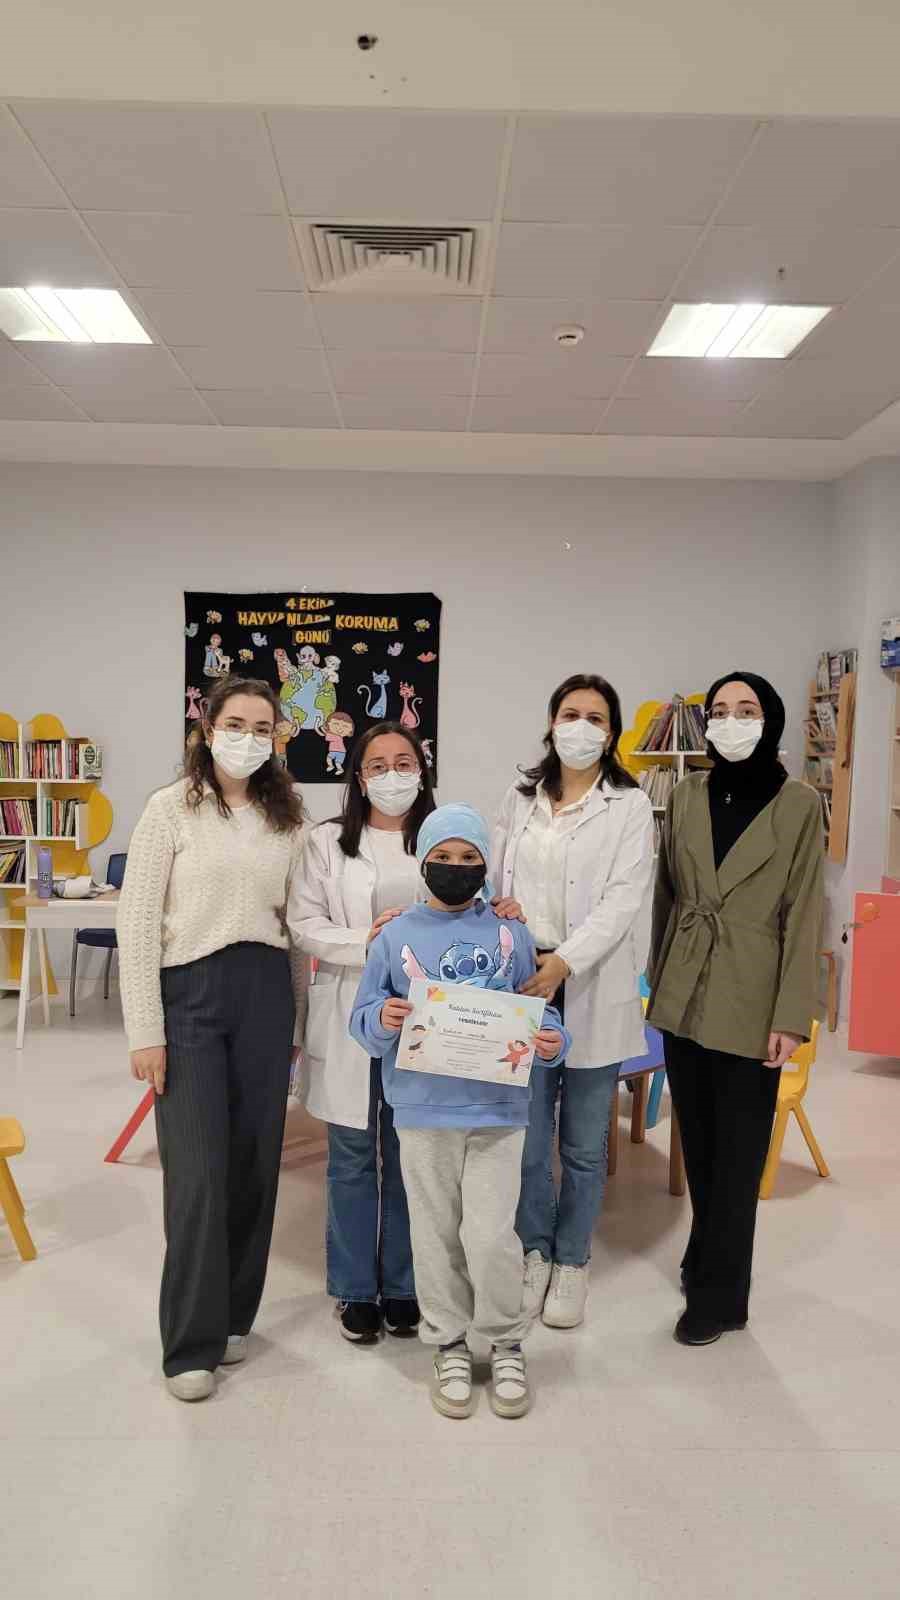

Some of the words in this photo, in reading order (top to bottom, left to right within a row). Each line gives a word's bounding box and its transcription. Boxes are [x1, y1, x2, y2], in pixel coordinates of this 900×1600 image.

[286, 598, 296, 610] 4
[237, 611, 330, 626] HAYVANLAR
[335, 614, 400, 631] KORUMA
